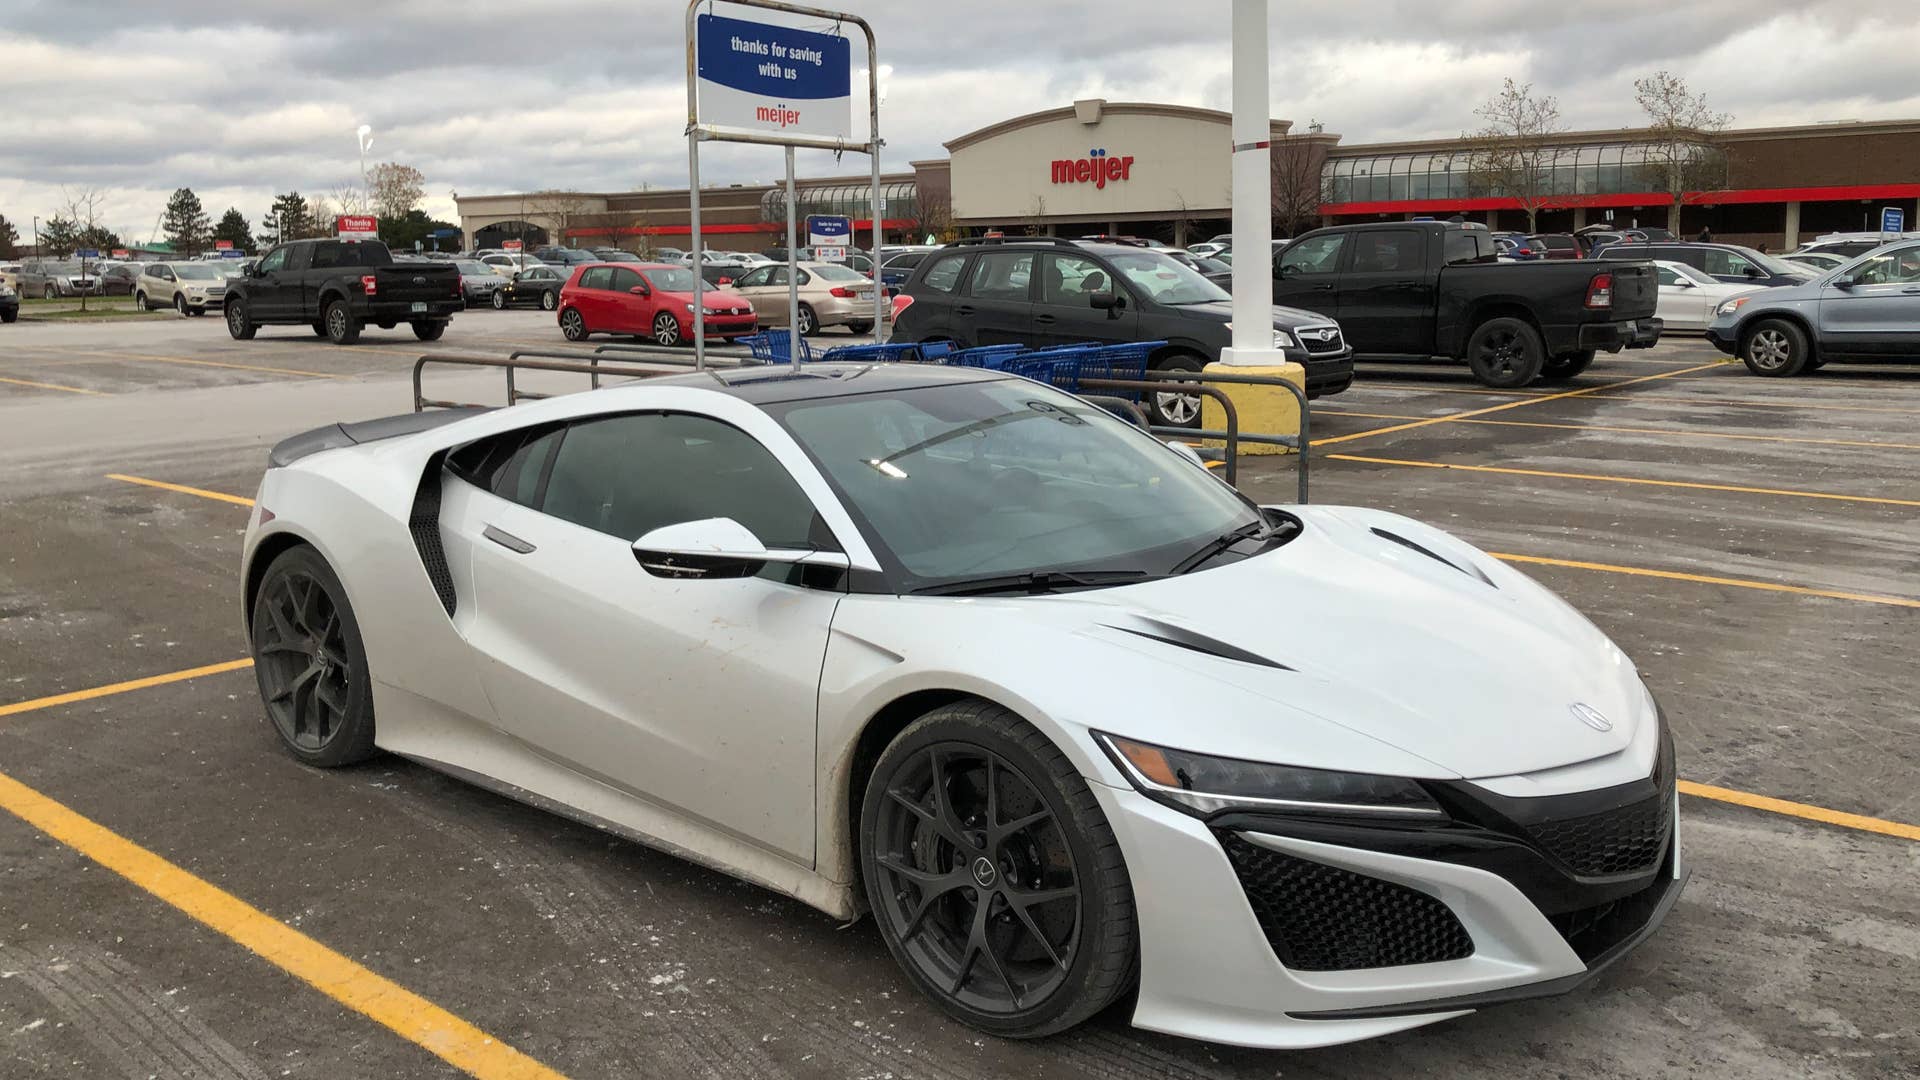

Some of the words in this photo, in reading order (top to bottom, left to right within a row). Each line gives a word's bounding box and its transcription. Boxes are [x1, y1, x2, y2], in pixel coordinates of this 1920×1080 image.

[731, 36, 769, 55] thanks
[771, 41, 787, 58] for
[789, 47, 823, 66] saving
[758, 62, 781, 78] with
[784, 67, 797, 80] us
[756, 104, 800, 128] meijer
[1051, 148, 1134, 190] meijer
[344, 218, 372, 227] Thanks
